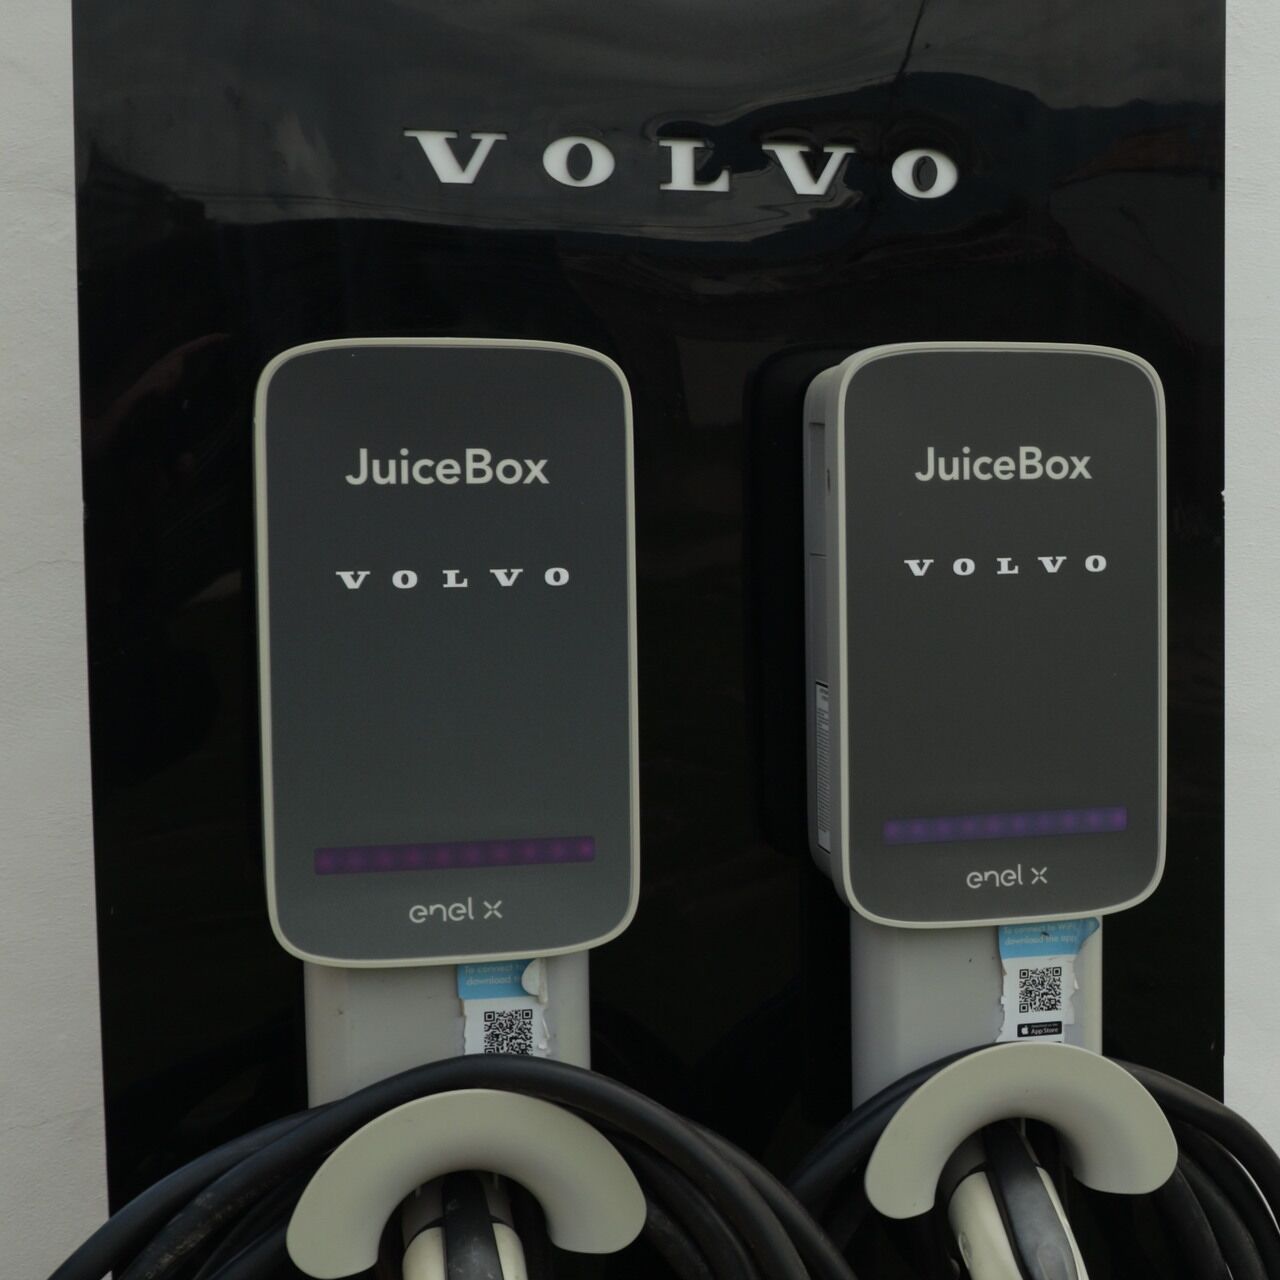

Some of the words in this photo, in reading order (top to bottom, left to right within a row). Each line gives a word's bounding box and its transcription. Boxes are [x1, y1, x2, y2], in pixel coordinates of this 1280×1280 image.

[403, 130, 959, 199] VOLVO
[345, 447, 550, 486] JuiceBox
[914, 445, 1093, 482] JuiceBox
[335, 567, 570, 590] VOLVO
[903, 554, 1107, 577] VOLVO
[966, 863, 1024, 889] enel
[408, 896, 475, 924] enel
